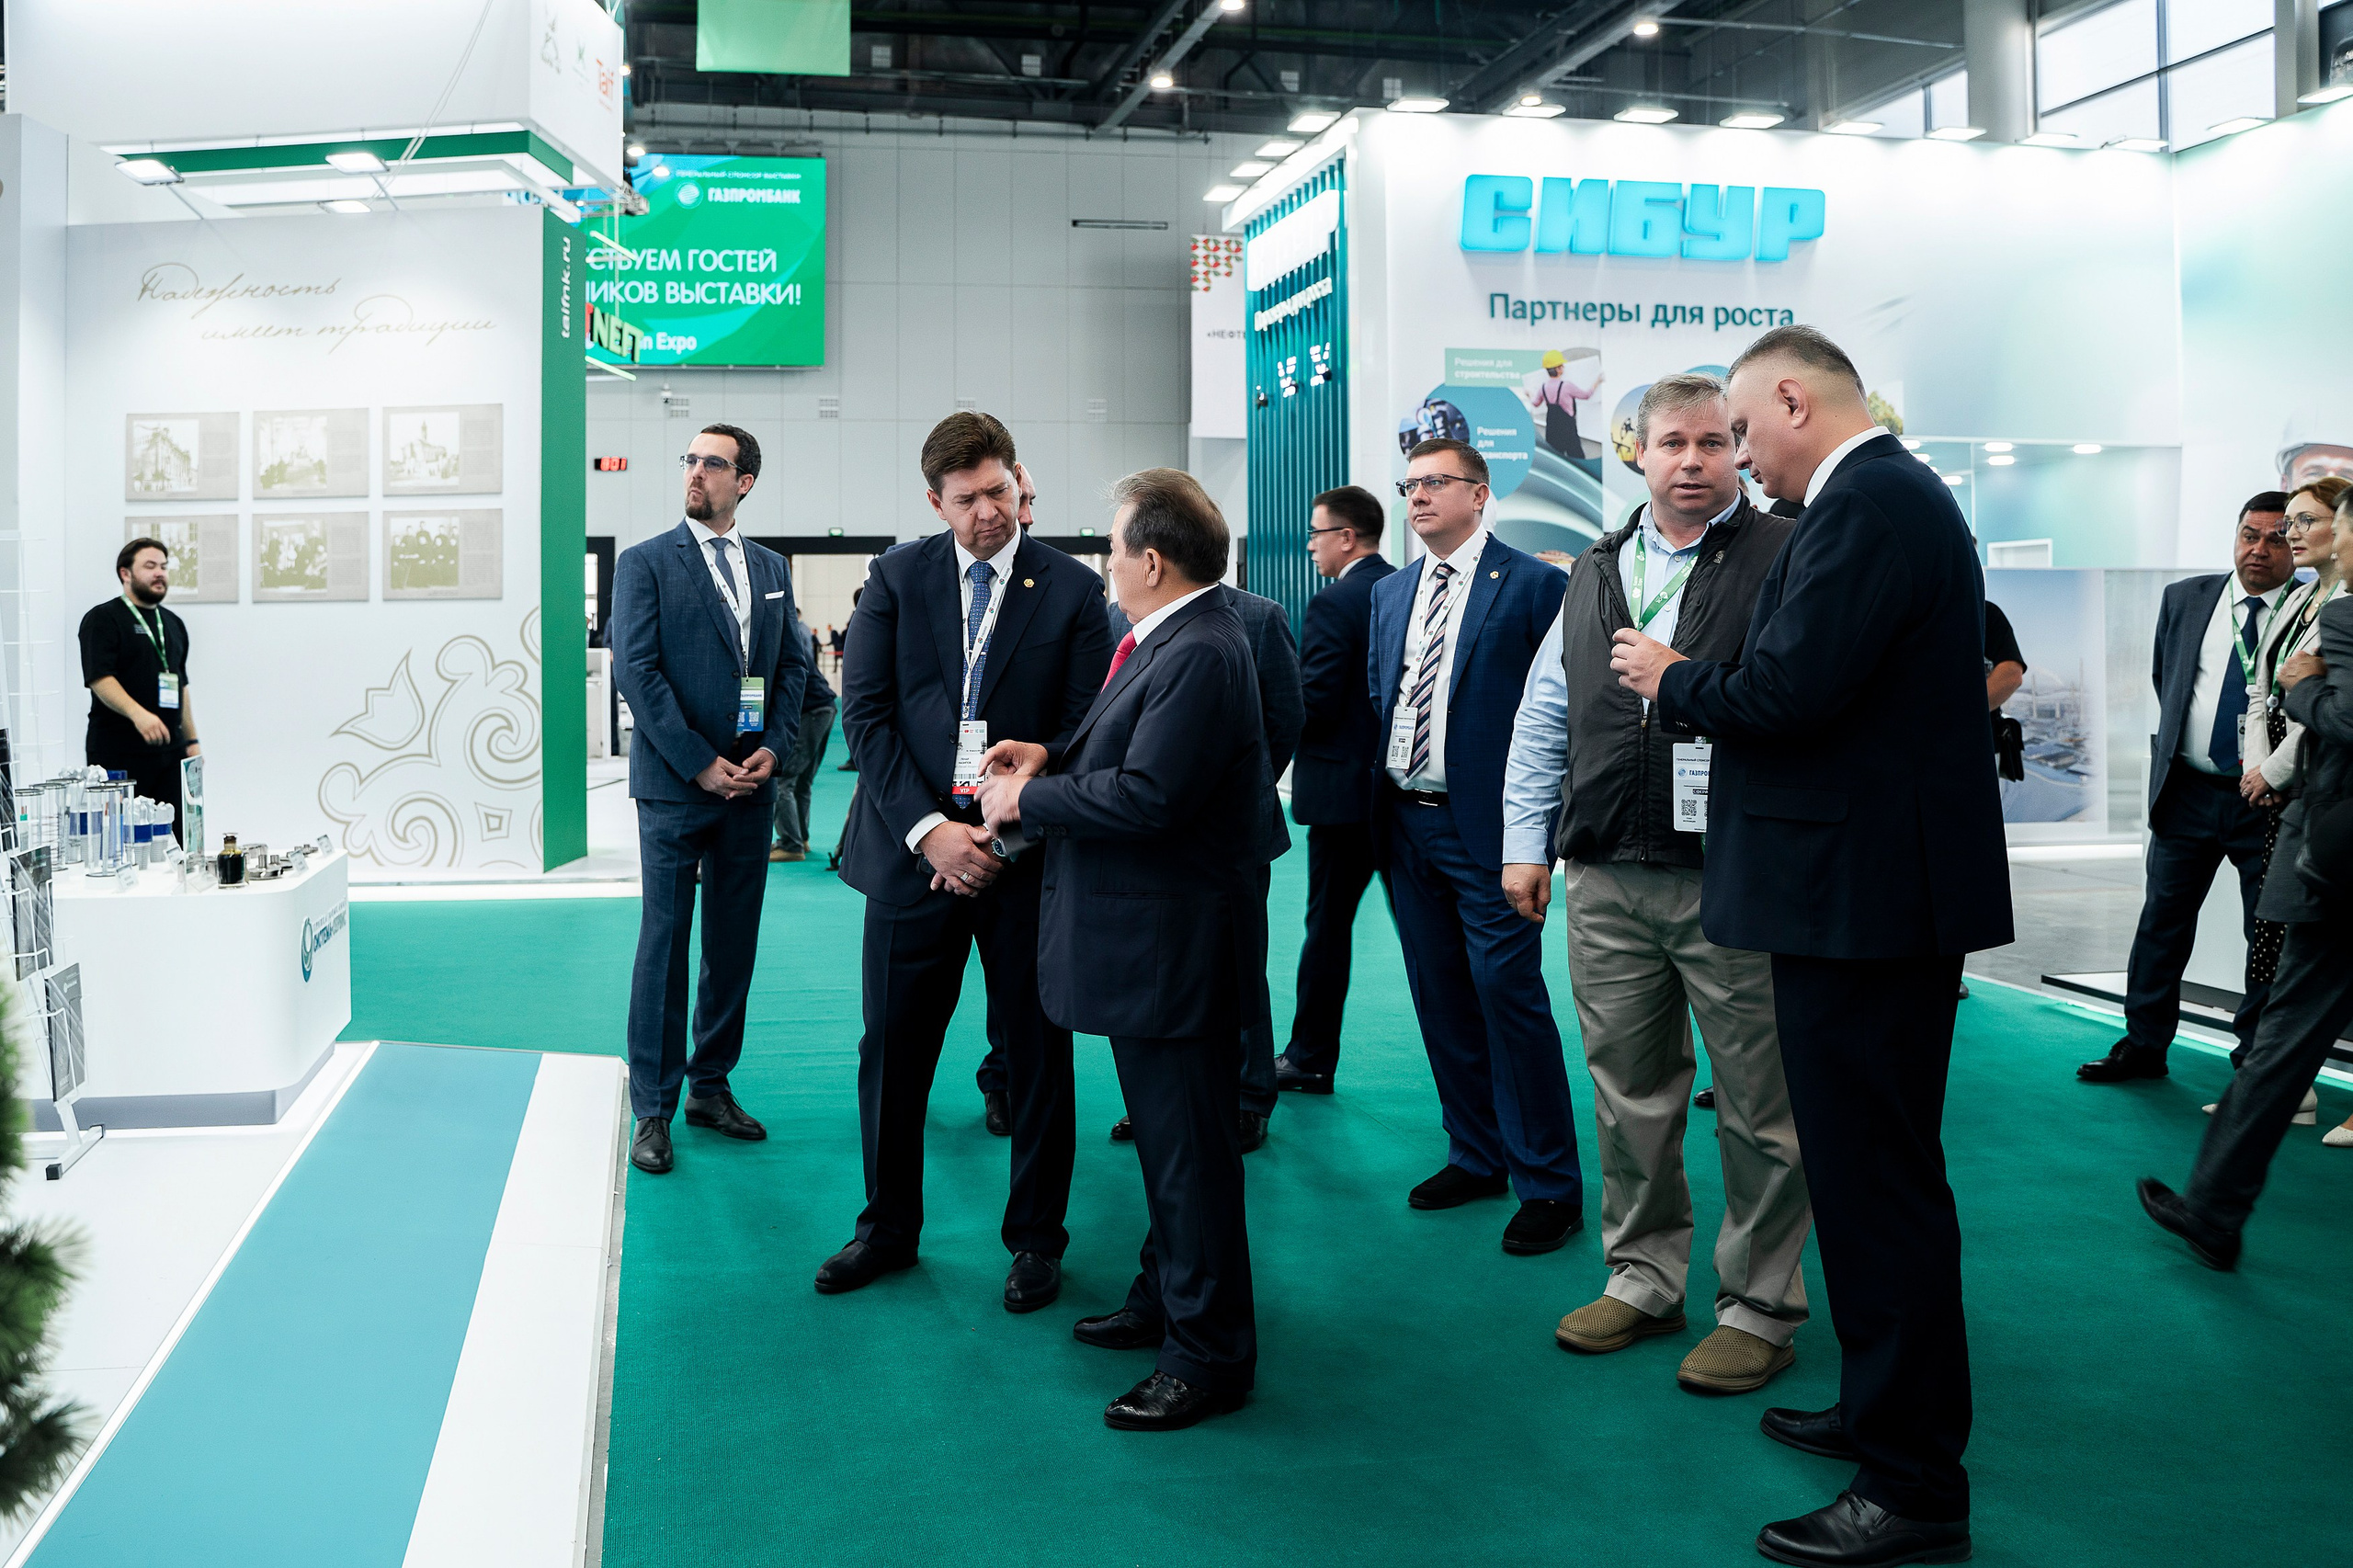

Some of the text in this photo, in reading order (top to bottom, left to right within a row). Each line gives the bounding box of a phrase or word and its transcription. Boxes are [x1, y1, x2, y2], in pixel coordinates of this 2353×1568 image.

[707, 187, 801, 204] ГАЗПРОМБАНК
[1460, 174, 1825, 262] СИБУР
[585, 247, 778, 273] СТВУЕМ ГОСТЕЙ
[665, 280, 801, 306] ВЫСТАВКИ!
[1488, 292, 1794, 332] Партнеры для роста
[656, 332, 698, 354] Expo
[1476, 426, 1518, 437] Решения
[1476, 439, 1495, 449] для
